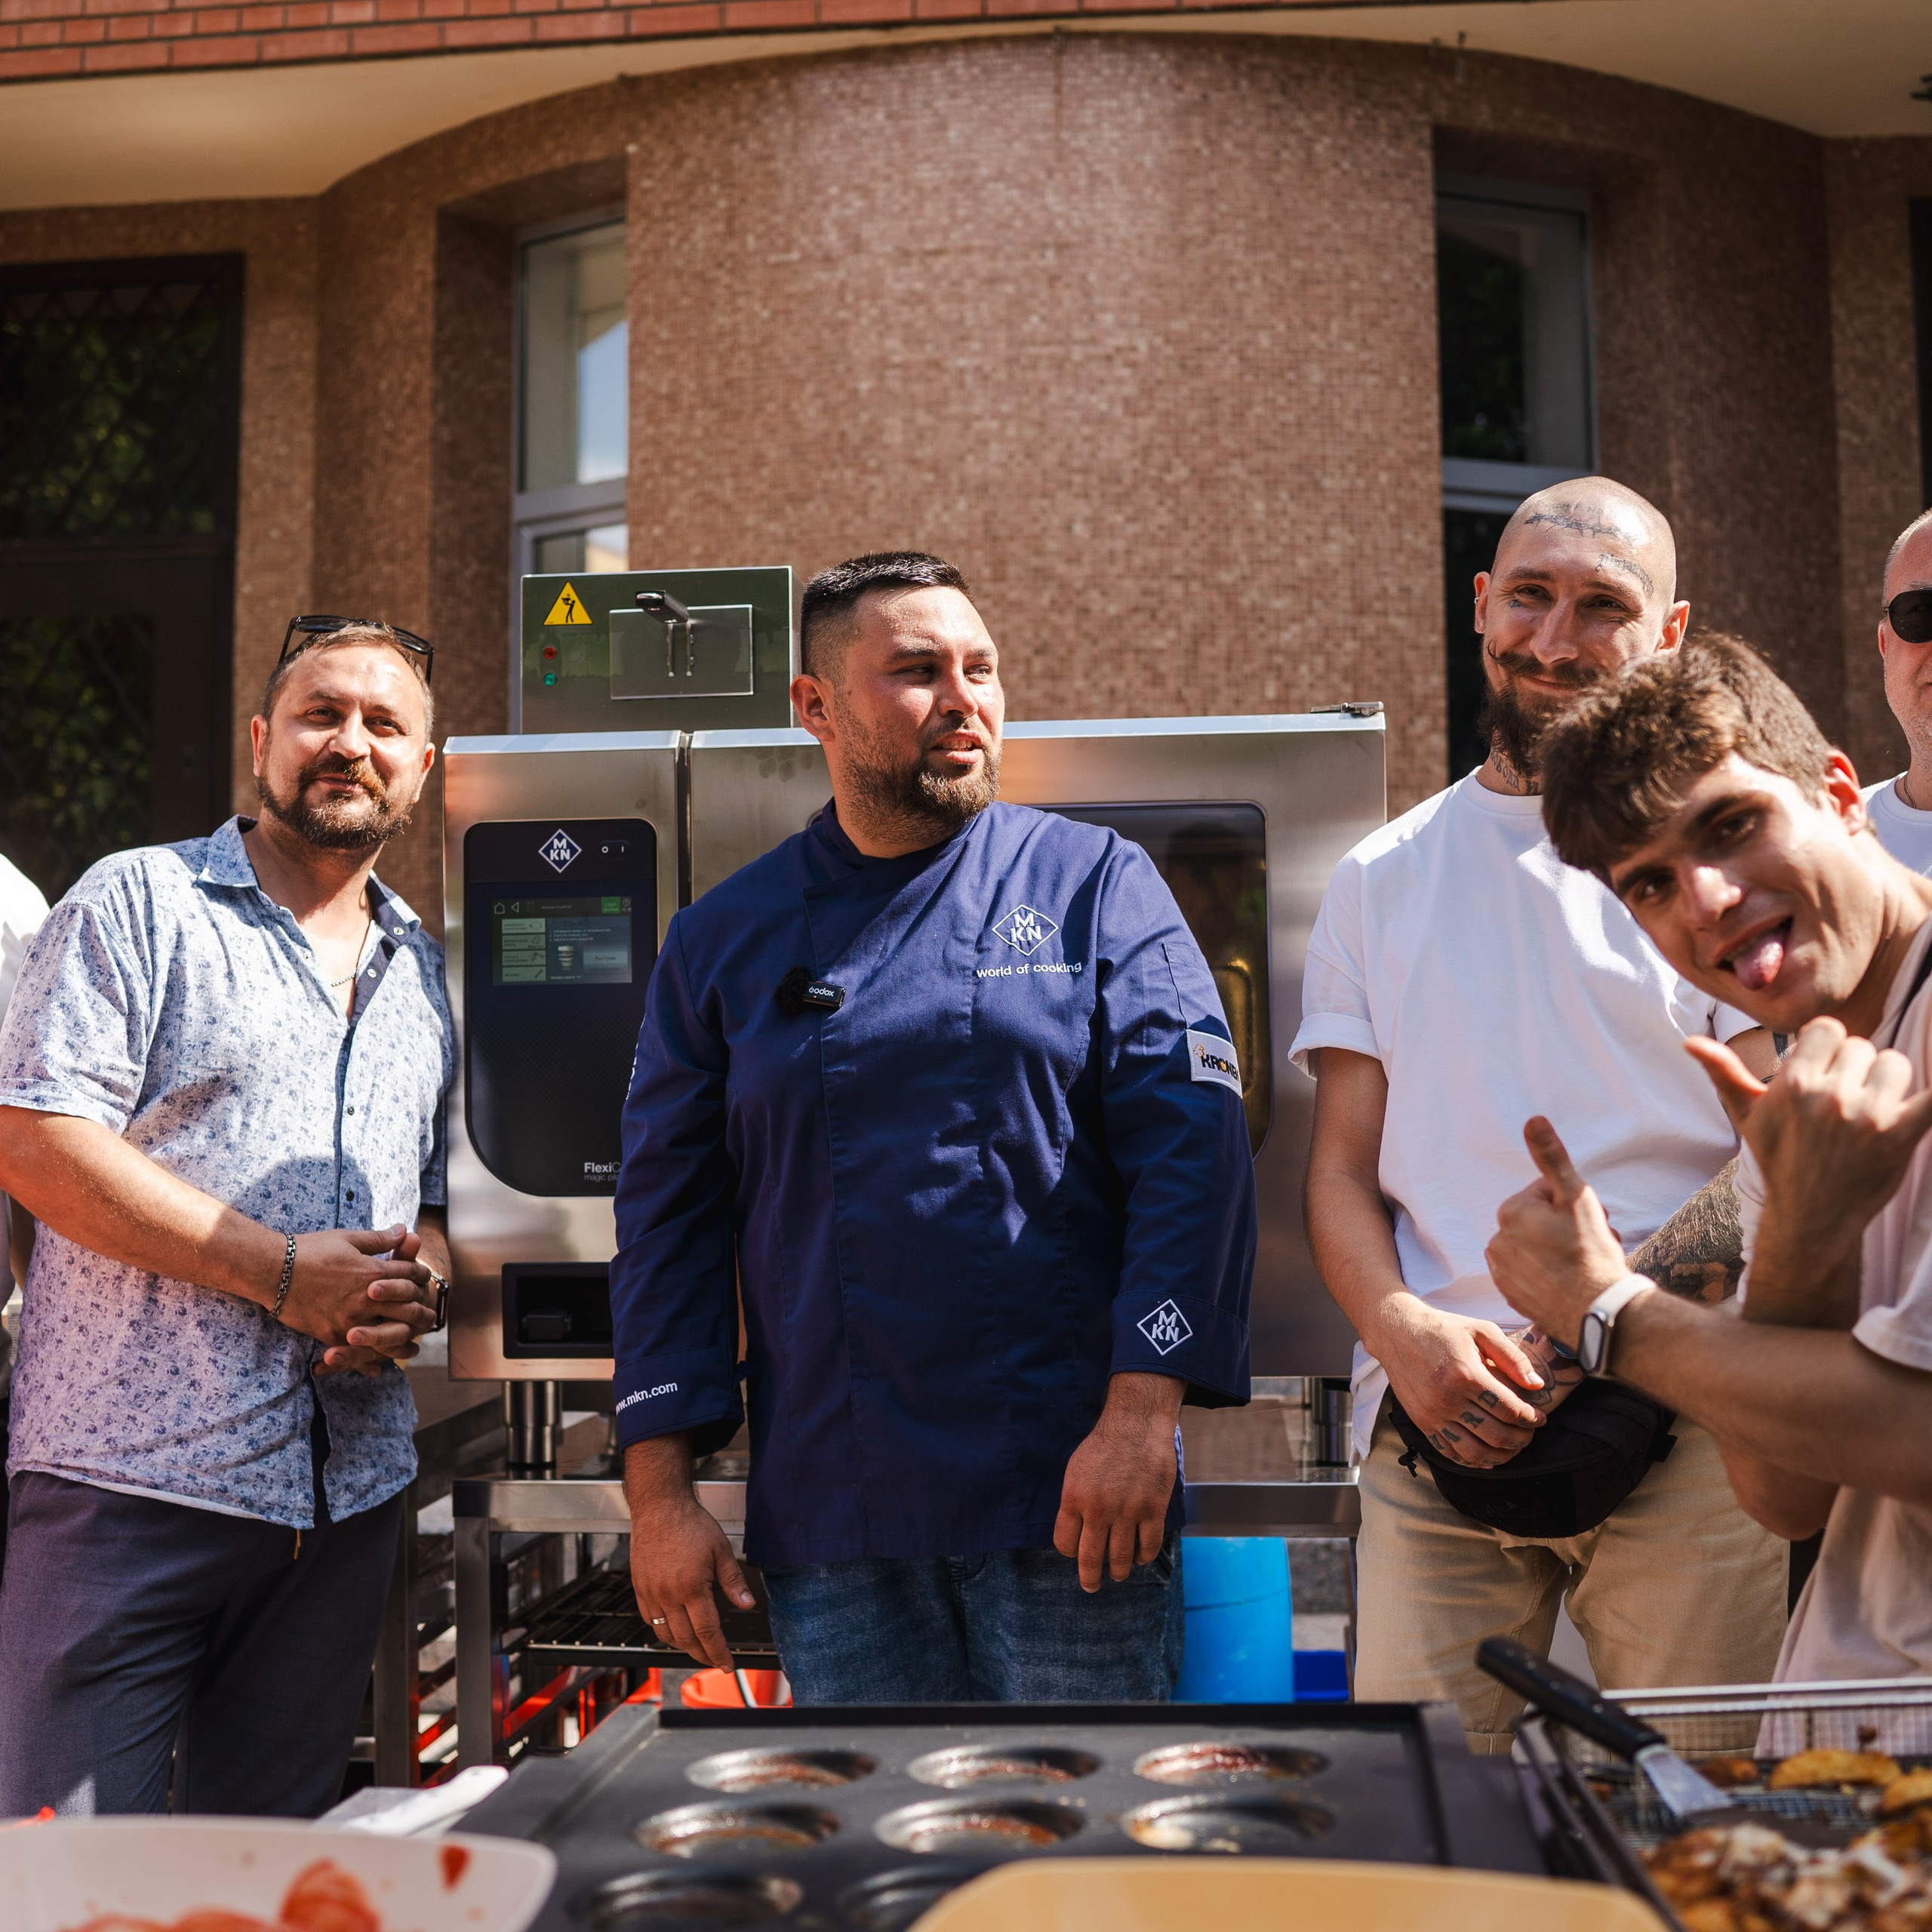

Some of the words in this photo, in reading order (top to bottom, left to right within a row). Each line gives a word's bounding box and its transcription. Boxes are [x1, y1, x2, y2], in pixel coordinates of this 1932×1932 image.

[977, 965, 1012, 977] world
[1016, 964, 1029, 974] of
[1033, 962, 1082, 973] cooking
[808, 986, 835, 996] Godox
